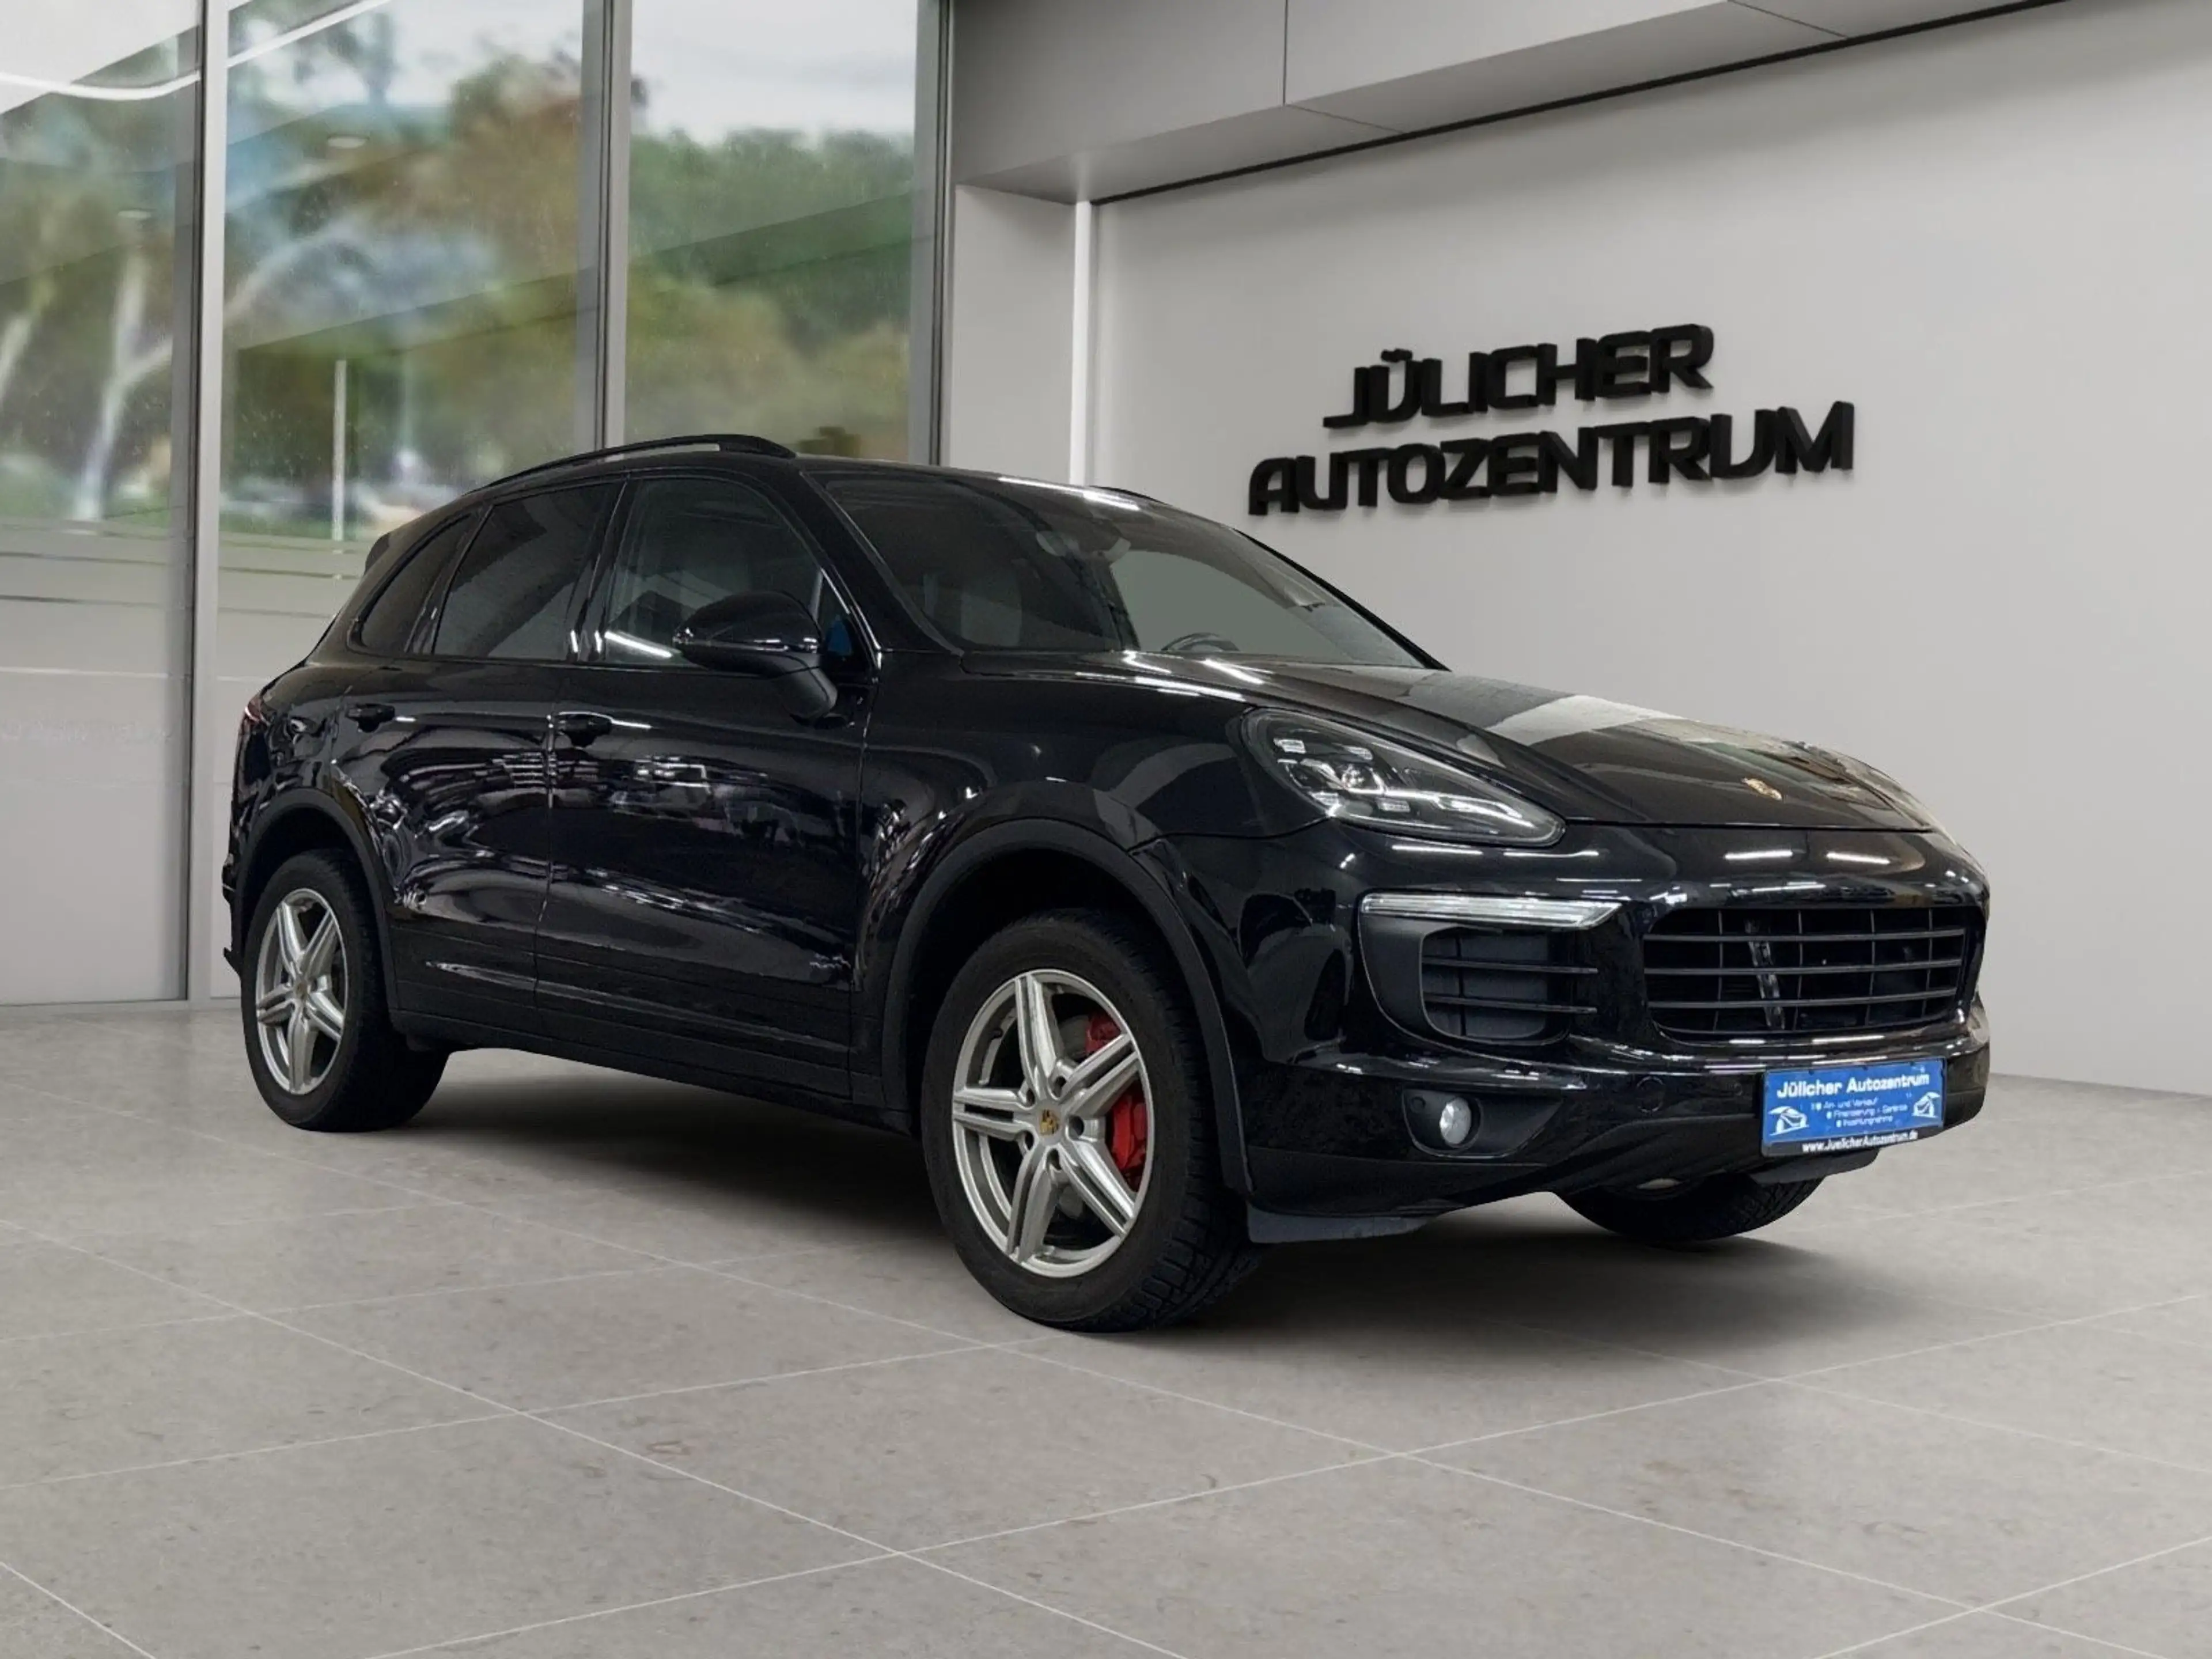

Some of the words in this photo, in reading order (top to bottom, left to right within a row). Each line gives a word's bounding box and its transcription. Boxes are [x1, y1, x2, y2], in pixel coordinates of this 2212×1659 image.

[1323, 324, 1714, 429] JÜLICHER
[1248, 401, 1854, 516] AUTOZENTRUM
[1777, 1080, 1843, 1097] Jülicher
[1846, 1074, 1929, 1093] Autozentrum
